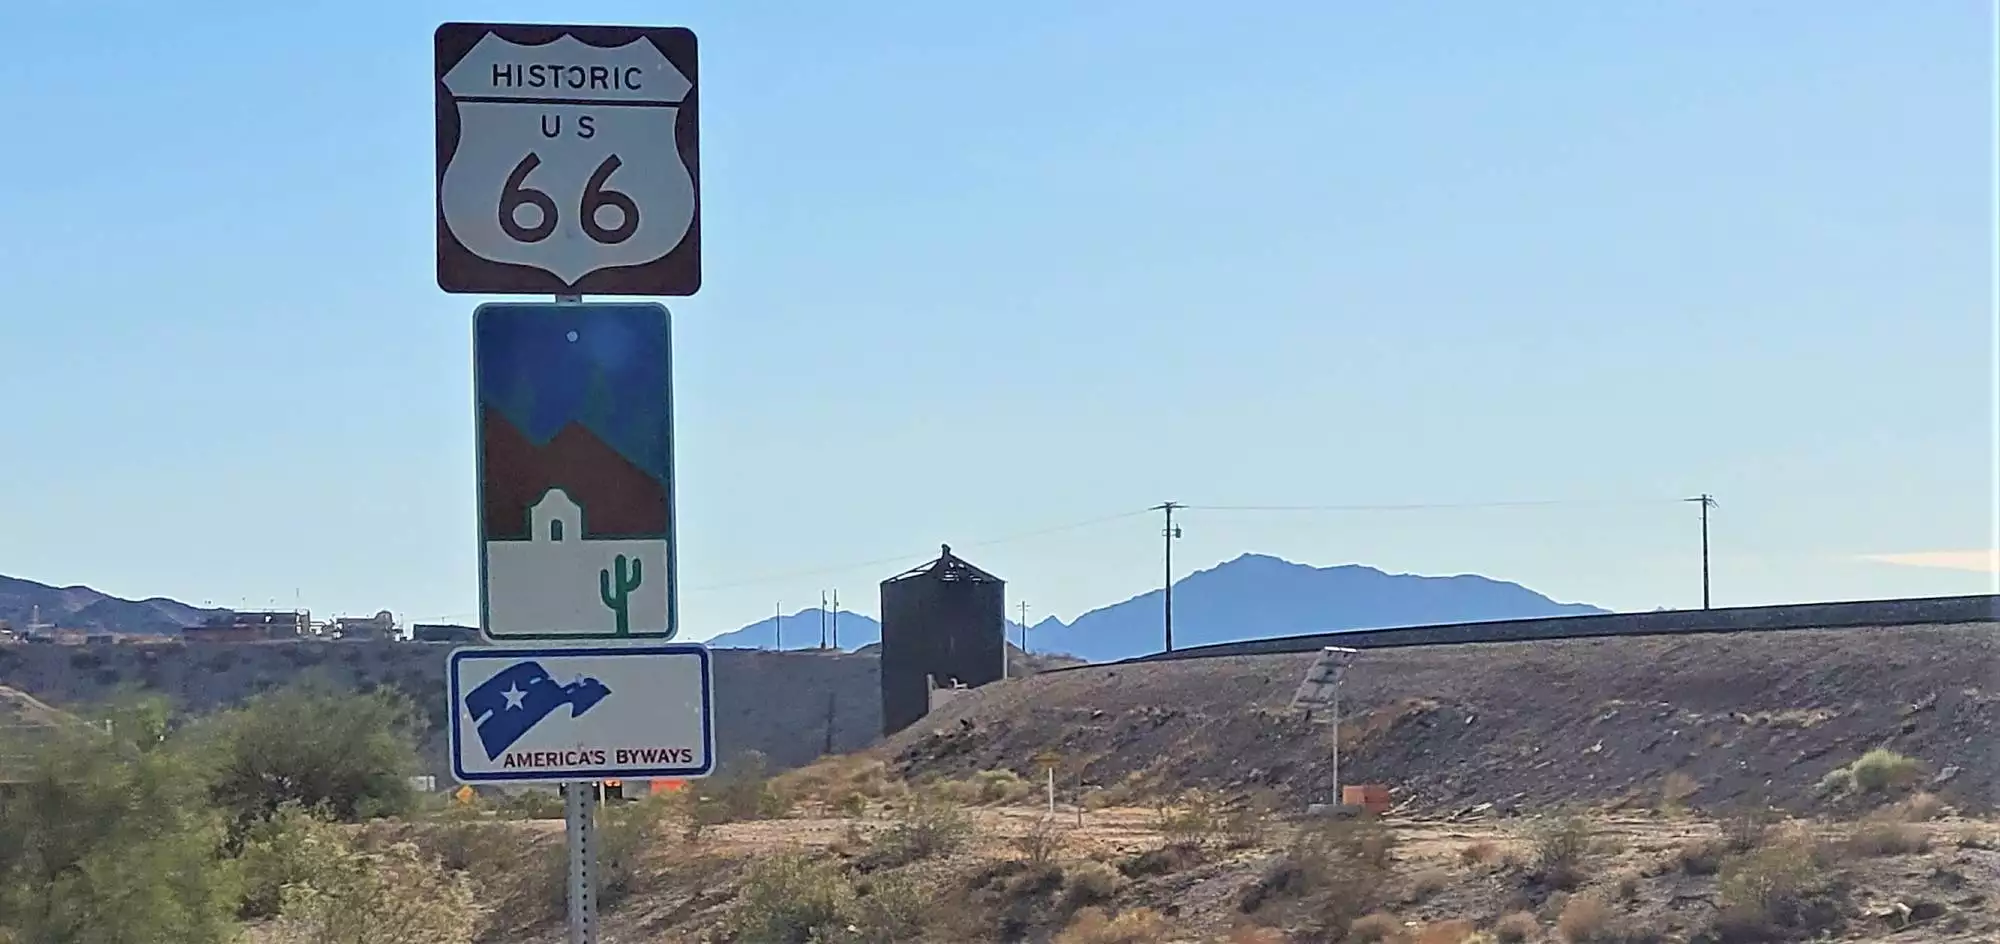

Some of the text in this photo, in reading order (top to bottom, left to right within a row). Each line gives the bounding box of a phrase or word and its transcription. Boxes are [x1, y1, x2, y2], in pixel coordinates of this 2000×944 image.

[492, 63, 642, 91] HISTORIC
[498, 151, 640, 244] 66
[503, 748, 693, 769] AMERICA'S BYWAYS
